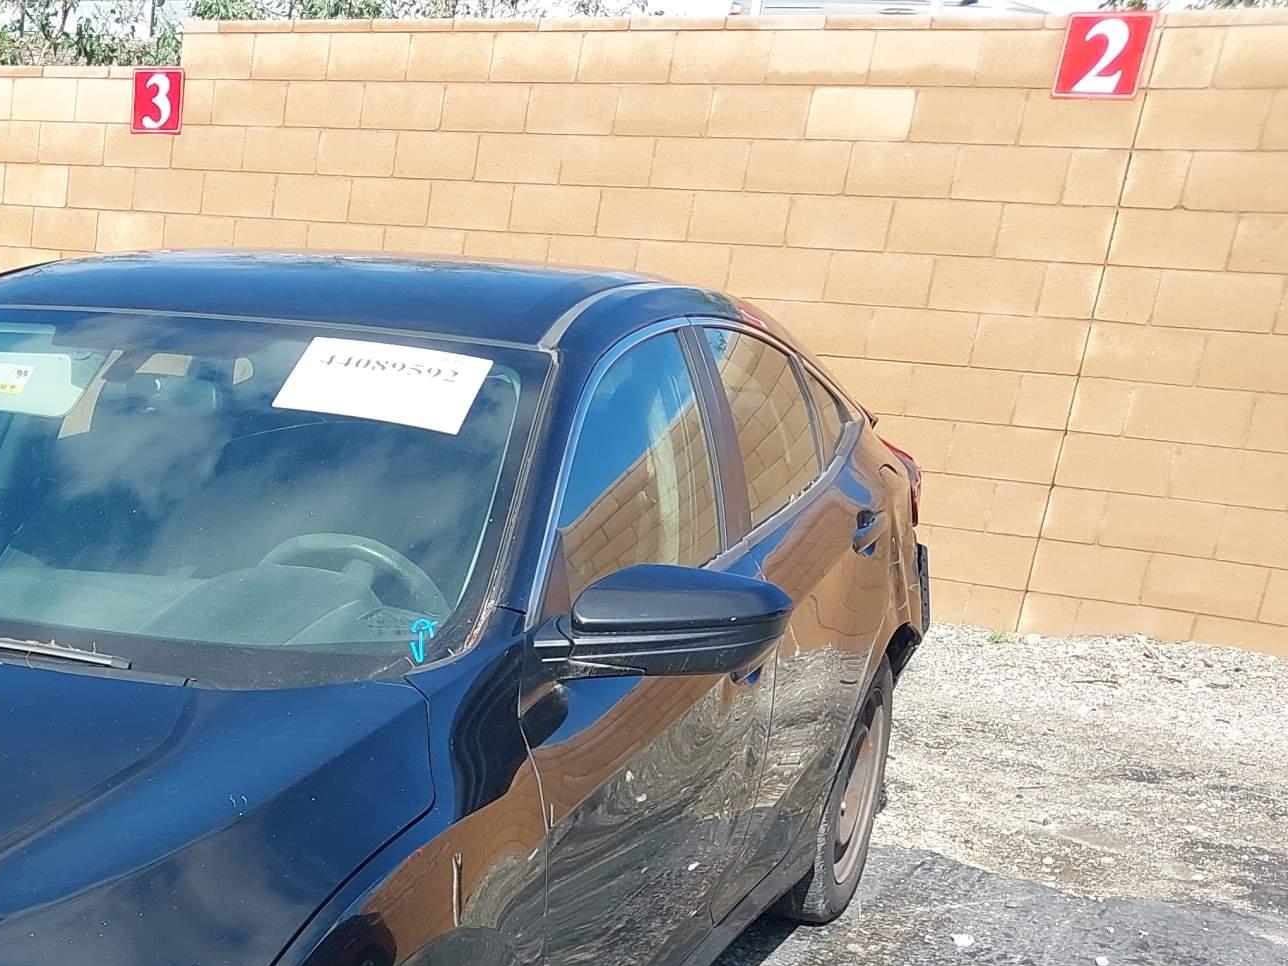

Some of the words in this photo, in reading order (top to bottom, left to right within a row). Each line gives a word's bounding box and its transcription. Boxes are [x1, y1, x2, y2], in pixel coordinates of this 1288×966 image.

[1071, 18, 1128, 93] 2
[142, 73, 171, 128] 3
[319, 354, 459, 382] 44089592
